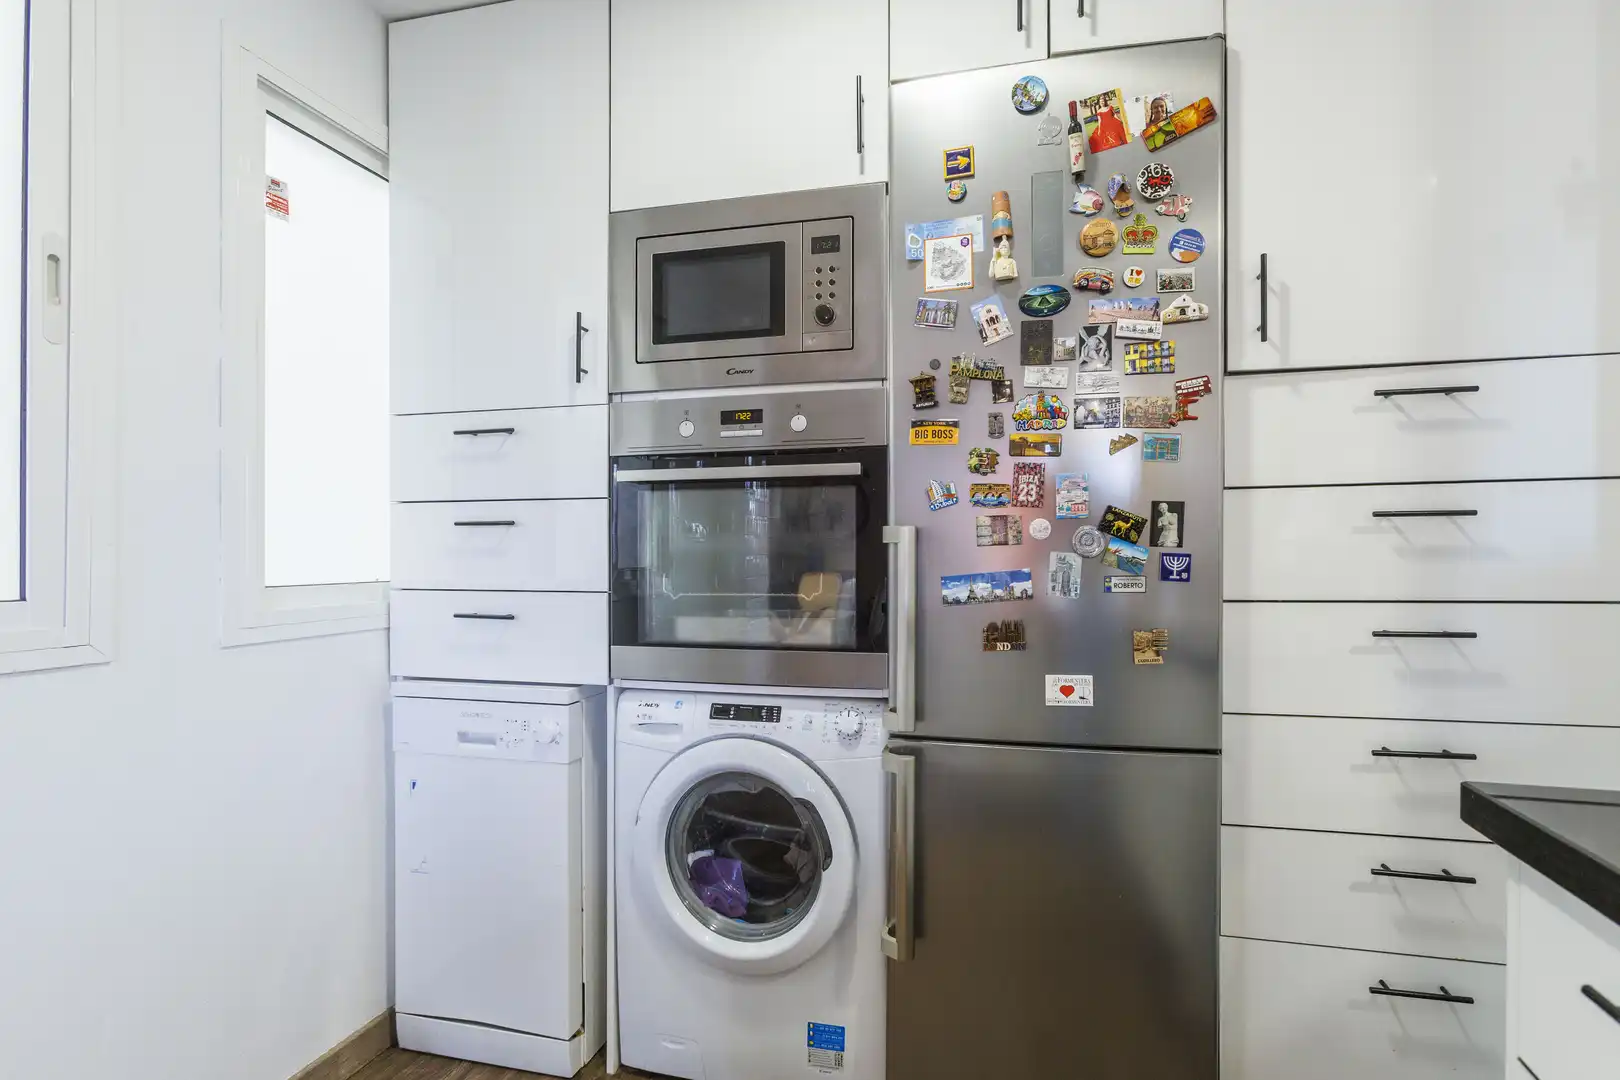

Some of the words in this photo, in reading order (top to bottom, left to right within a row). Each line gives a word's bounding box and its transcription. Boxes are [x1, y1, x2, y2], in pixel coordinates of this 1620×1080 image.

[949, 362, 1004, 379] PAMPLONA
[1016, 419, 1067, 431] MADRID
[915, 429, 929, 439] BIG
[931, 429, 954, 439] BOSS
[1019, 475, 1039, 485] IBIZA
[1019, 484, 1037, 501] 23
[1112, 507, 1143, 522] LANZAROTE
